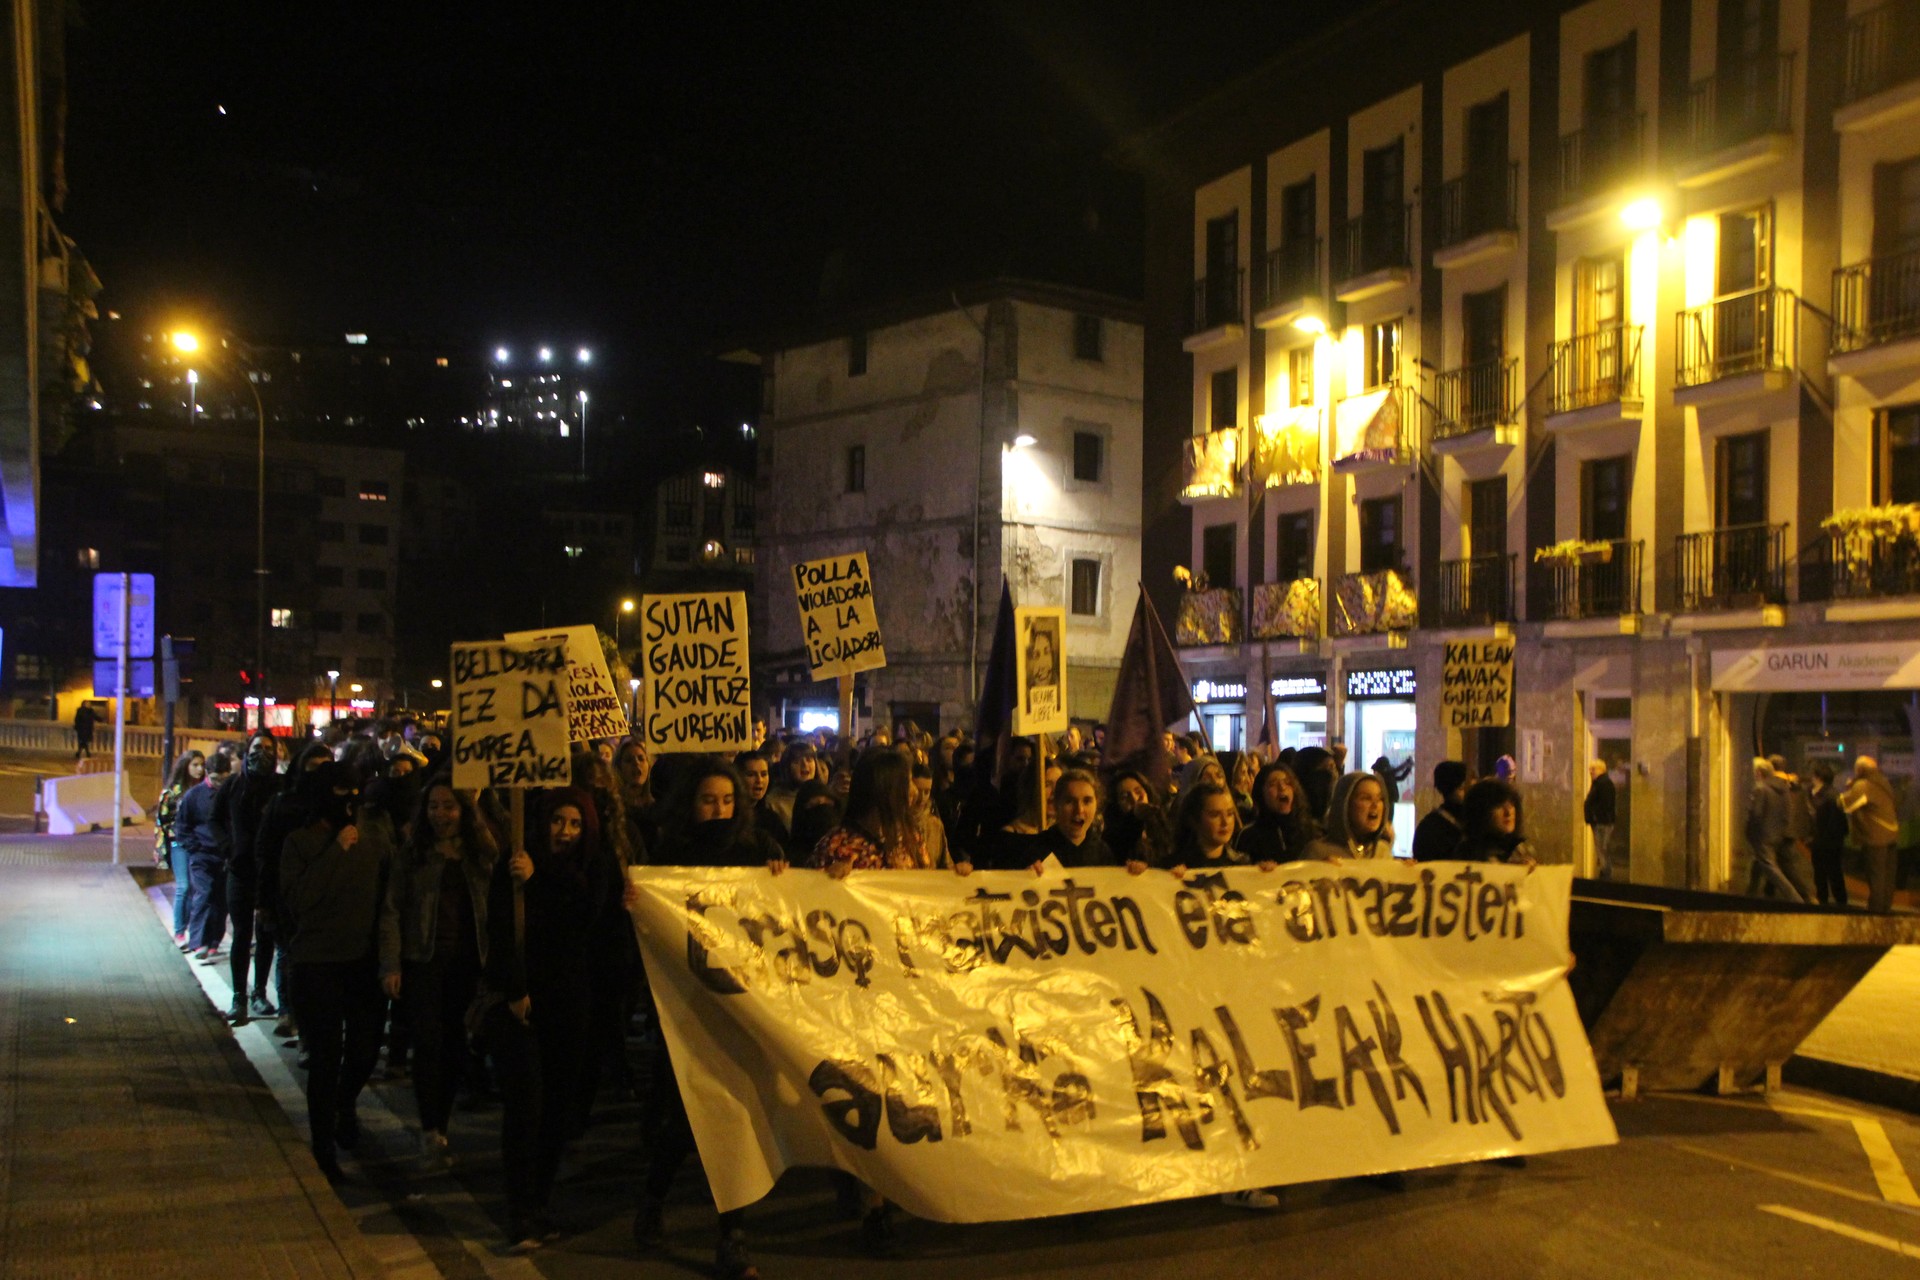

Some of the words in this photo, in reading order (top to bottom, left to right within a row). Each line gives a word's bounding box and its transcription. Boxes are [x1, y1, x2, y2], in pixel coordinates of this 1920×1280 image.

[796, 559, 862, 588] POLLA
[646, 596, 735, 642] SUTAN
[807, 616, 821, 639] A
[837, 606, 860, 629] LA
[649, 638, 742, 674] GAUDE,
[1768, 653, 1828, 671] GARUN
[458, 688, 496, 727] EZ
[521, 680, 564, 720] DA
[655, 675, 749, 709] KONTUZ
[1452, 706, 1493, 725] DIRA
[455, 729, 536, 764] GUREA
[1110, 979, 1432, 1152] KALEAK
[1414, 989, 1566, 1142] HARTU
